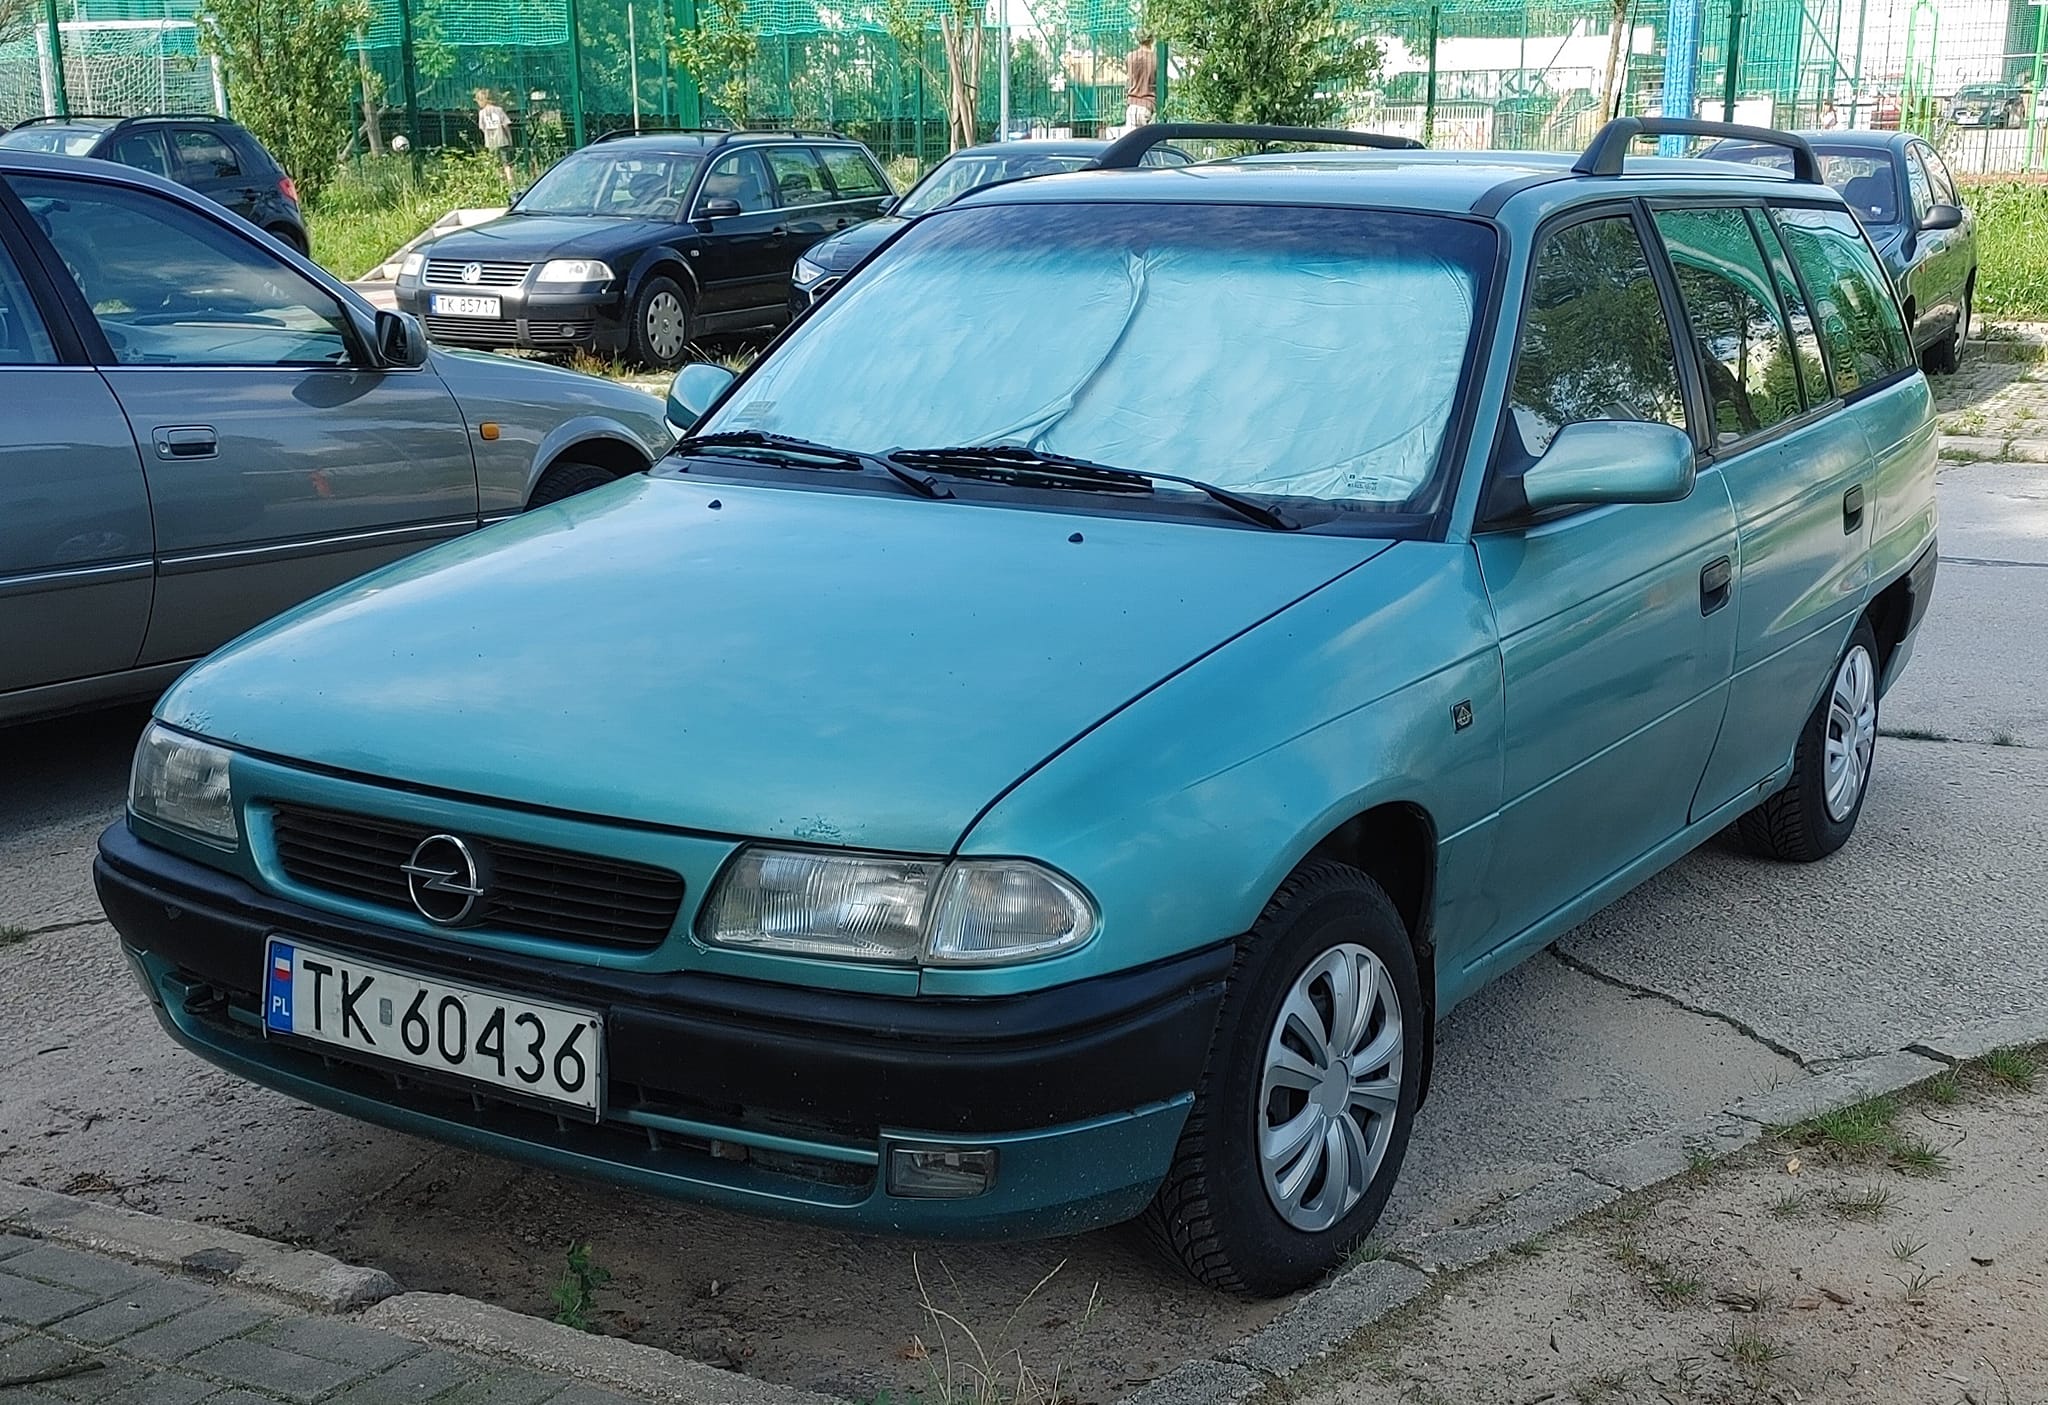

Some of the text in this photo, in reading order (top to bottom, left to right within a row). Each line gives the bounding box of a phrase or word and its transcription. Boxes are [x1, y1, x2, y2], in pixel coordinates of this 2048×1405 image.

[440, 297, 497, 314] TK 85717
[272, 997, 290, 1016] PL
[303, 959, 586, 1093] TK 60436
